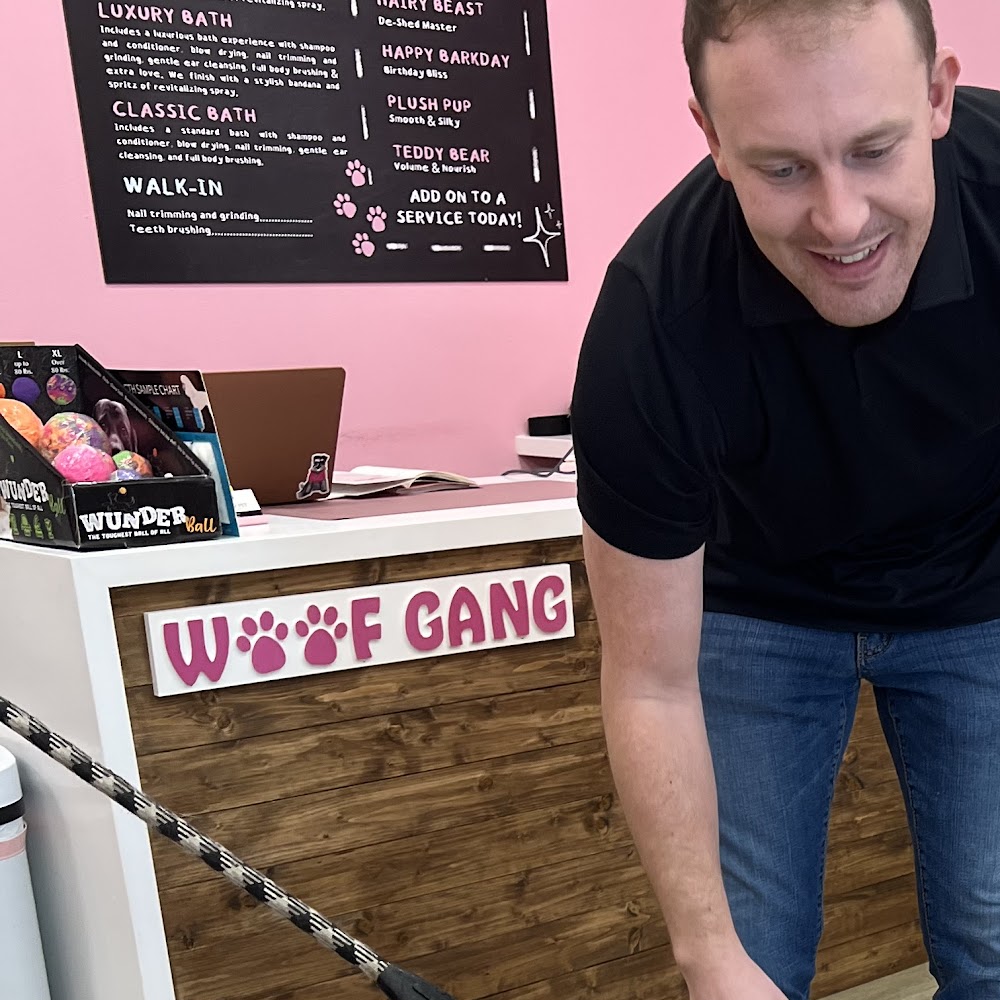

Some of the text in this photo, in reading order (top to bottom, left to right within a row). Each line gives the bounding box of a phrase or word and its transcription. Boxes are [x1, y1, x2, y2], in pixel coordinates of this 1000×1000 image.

[98, 2, 233, 28] LUXURY BATH
[433, 0, 484, 16] BEAST
[378, 16, 457, 32] De-Shed Master
[99, 25, 141, 37] Includes
[153, 29, 195, 41] luxurious
[197, 33, 218, 43] bath
[220, 36, 276, 48] experience
[278, 40, 297, 50] with
[299, 42, 336, 53] shampoo
[101, 40, 119, 48] and
[190, 46, 211, 55] blow
[256, 52, 272, 60] nail
[323, 57, 338, 65] and
[382, 44, 510, 69] HAPPY BARKDAY
[147, 56, 181, 67] gentle
[251, 62, 267, 72] full
[268, 65, 291, 76] body
[292, 66, 329, 79] brushing
[330, 68, 339, 79] &
[383, 65, 449, 80] Birthday Bliss
[105, 67, 135, 76] extra
[167, 70, 184, 80] We
[189, 71, 216, 82] finish
[220, 74, 240, 83] with
[253, 77, 285, 87] stylish
[288, 79, 322, 89] bandana
[325, 82, 341, 91] and
[108, 80, 138, 90] spritz
[140, 81, 151, 90] of
[153, 83, 209, 96] revitalizing
[112, 100, 257, 123] CLASSIC BATH
[387, 94, 472, 112] PLUSH PUP
[389, 114, 461, 129] Smooth & Silky
[114, 122, 155, 133] Includes
[181, 127, 220, 136] standard
[229, 128, 250, 138] bath
[258, 131, 278, 139] with
[286, 132, 324, 142] shampoo
[331, 135, 347, 143] and
[177, 140, 197, 148] blow
[298, 147, 328, 156] gentle
[392, 144, 490, 163] TEDDY BEAR
[185, 153, 200, 162] full
[201, 155, 223, 165] body
[393, 161, 477, 174] Volume & Nourish
[123, 176, 223, 197] WALK-IN
[409, 189, 507, 206] ADD ON TO A
[127, 208, 147, 218] Nail
[149, 209, 198, 221] trimming
[200, 211, 217, 220] and
[396, 210, 523, 229] SERVICE TODAY!
[129, 223, 166, 234] Teeth
[17, 351, 23, 359] L
[51, 349, 62, 358] XL
[159, 384, 180, 396] CHART
[0, 478, 49, 503] WUNDER
[79, 506, 218, 534] WUNDER Ball
[101, 531, 132, 539] TOUGHEST
[405, 574, 568, 652] GANG
